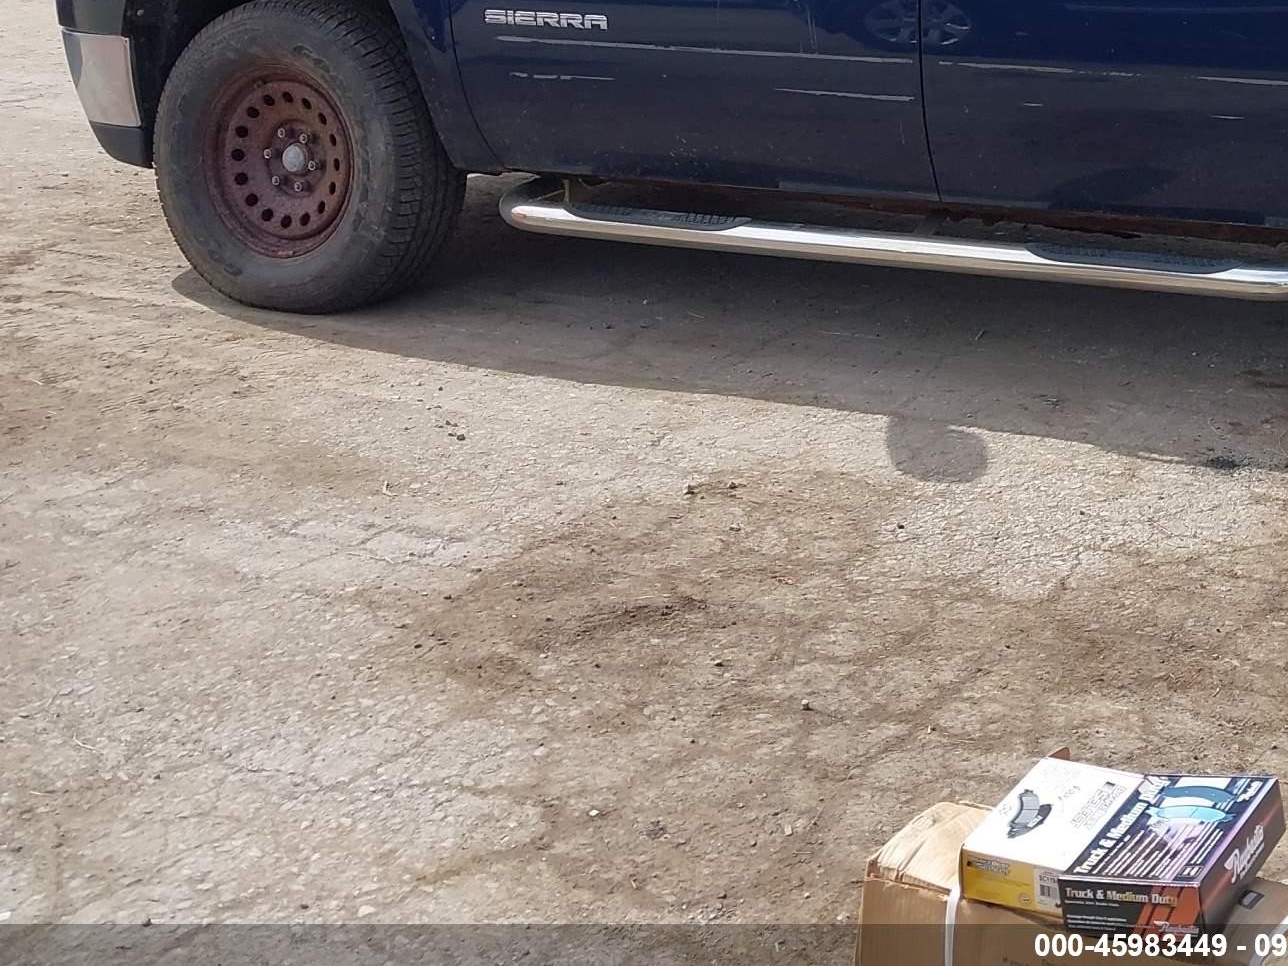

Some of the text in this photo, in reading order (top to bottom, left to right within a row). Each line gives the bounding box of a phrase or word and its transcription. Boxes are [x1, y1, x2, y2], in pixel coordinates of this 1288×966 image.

[484, 9, 608, 30] SIERRA
[1073, 847, 1109, 874] Truck
[1105, 801, 1150, 839] Medium
[1065, 887, 1178, 907] Truck & Medium Duty
